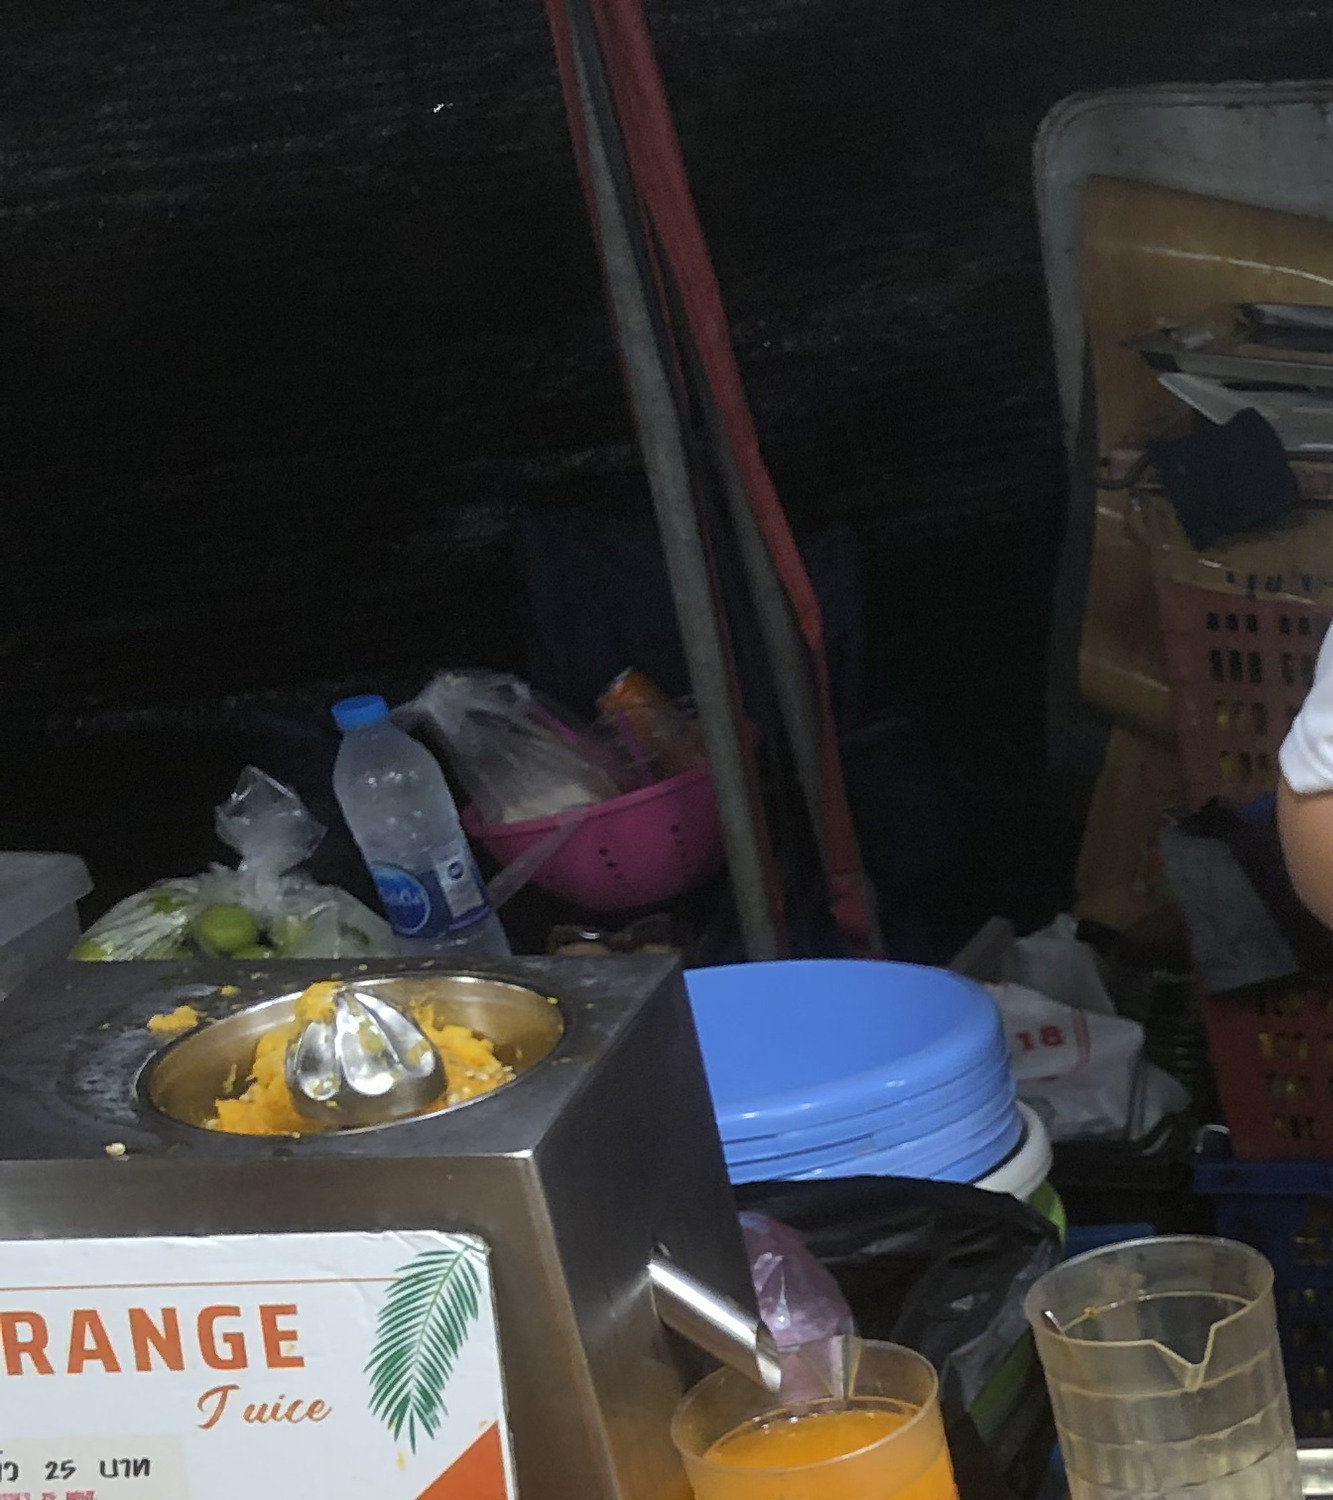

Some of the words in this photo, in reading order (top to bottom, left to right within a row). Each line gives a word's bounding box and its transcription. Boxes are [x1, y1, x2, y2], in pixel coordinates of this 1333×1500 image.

[196, 1384, 333, 1430] Juice
[45, 1459, 77, 1481] 25
[99, 1457, 151, 1479] บาท
